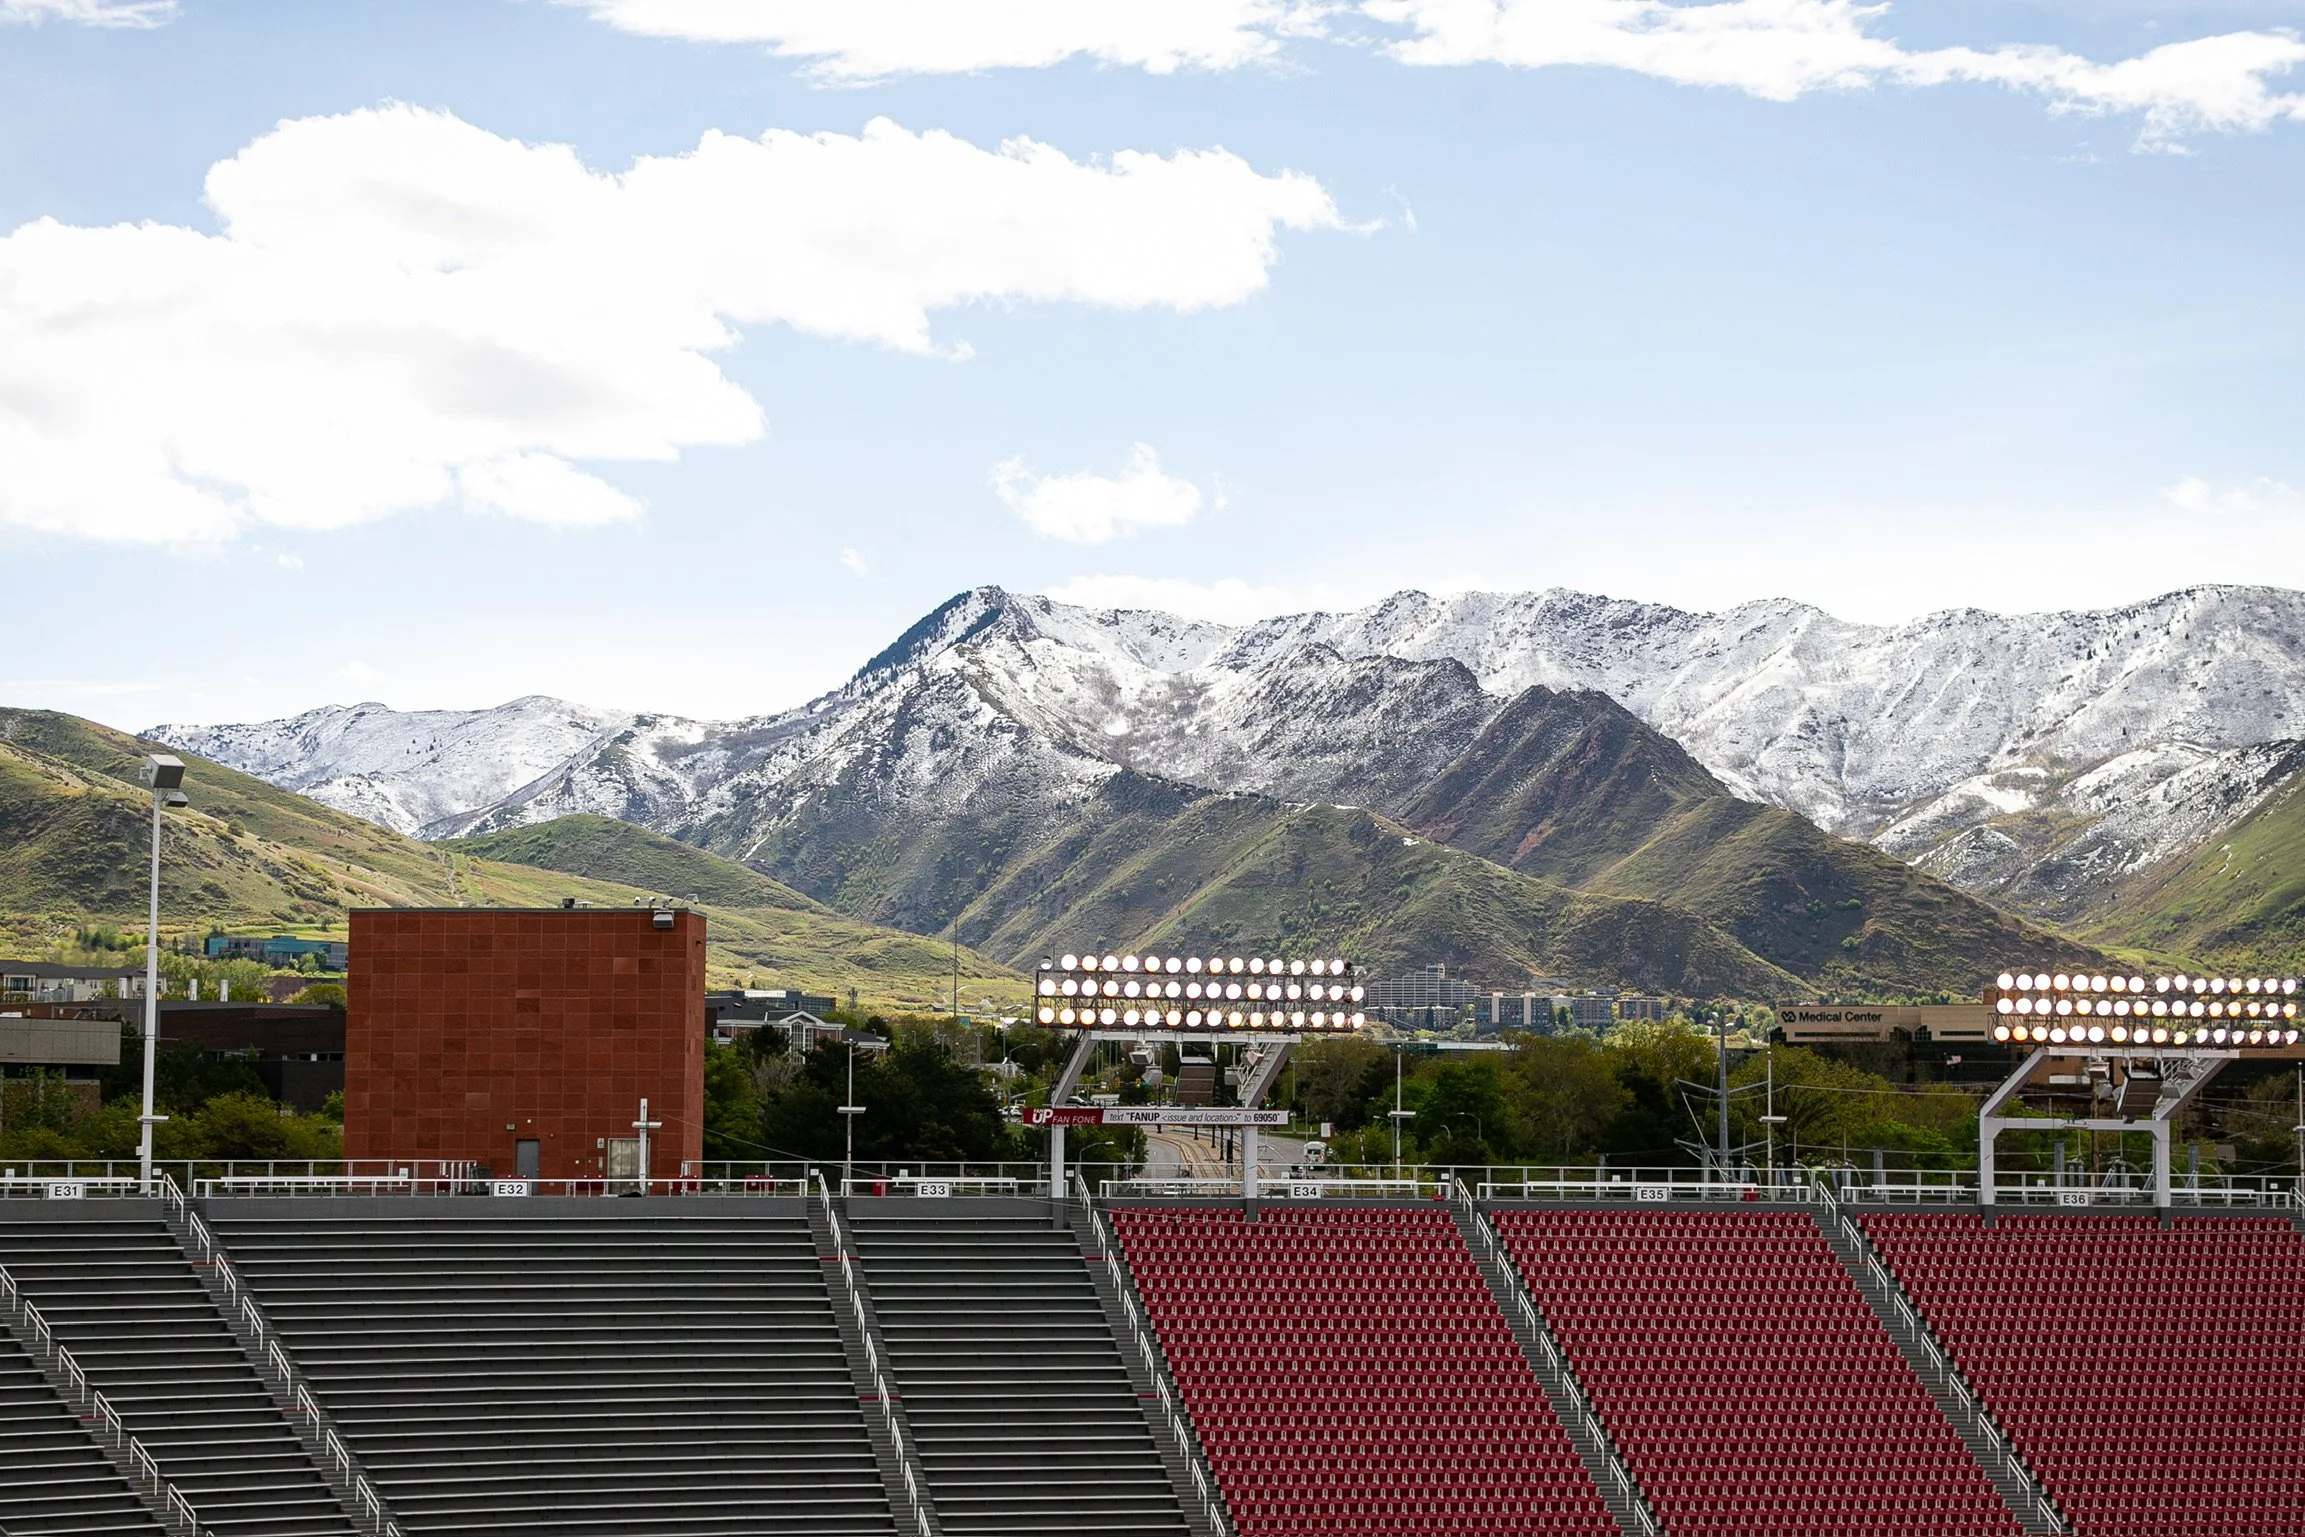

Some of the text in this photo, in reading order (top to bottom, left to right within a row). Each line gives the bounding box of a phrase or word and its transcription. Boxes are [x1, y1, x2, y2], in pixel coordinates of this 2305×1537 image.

[1800, 1011, 1842, 1022] Medical
[1845, 1011, 1882, 1023] Center
[1032, 1108, 1097, 1124] UP FAN FONE
[1109, 1112, 1124, 1121] text
[1162, 1113, 1187, 1122] <issue
[1188, 1112, 1203, 1122] and
[1244, 1113, 1252, 1122] to
[54, 1184, 78, 1197] E31
[498, 1183, 523, 1195] E32
[921, 1184, 946, 1196] E33
[1293, 1186, 1317, 1197] E34
[1640, 1188, 1664, 1200] E35
[2063, 1193, 2086, 1205] E36
